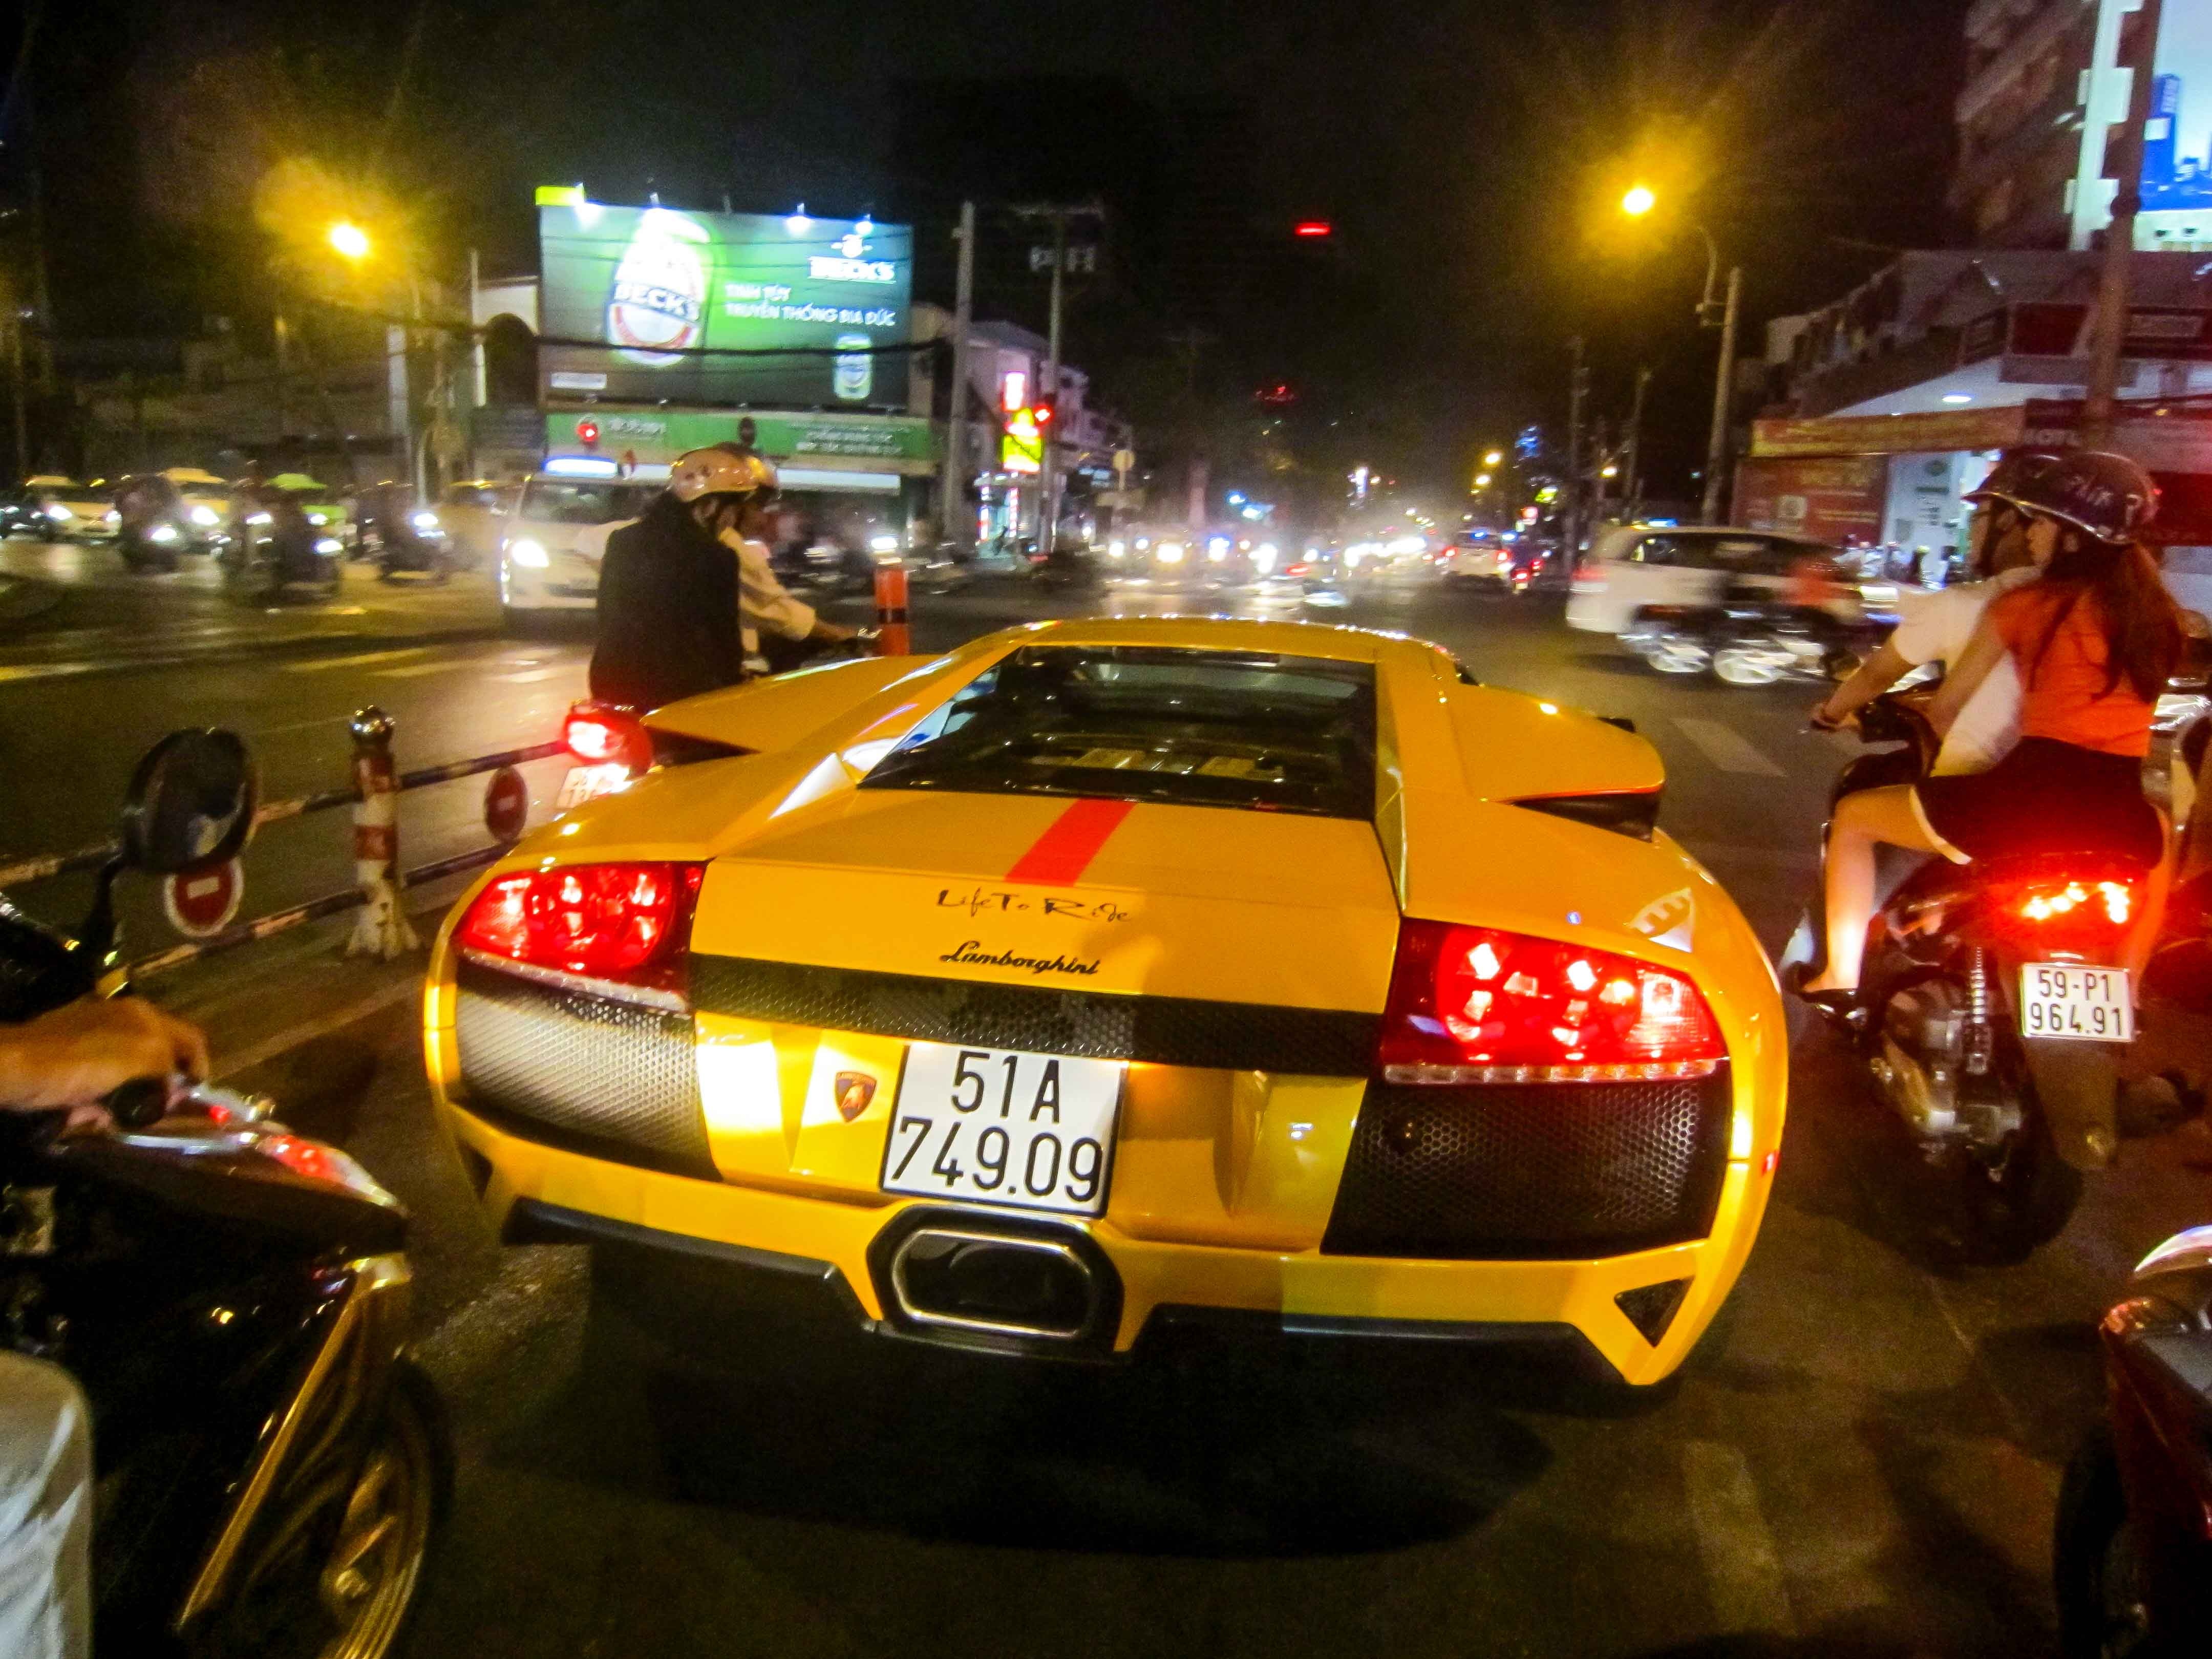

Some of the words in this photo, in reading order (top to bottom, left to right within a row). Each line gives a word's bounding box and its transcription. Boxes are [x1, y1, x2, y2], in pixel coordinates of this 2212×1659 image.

[937, 887, 992, 918] Life
[991, 893, 1029, 911] To
[1043, 898, 1129, 922] Ride
[940, 940, 1100, 975] Lamborghini
[2038, 969, 2110, 1002] 59-P1
[2030, 1002, 2122, 1036] 964.91
[951, 1051, 1060, 1123] 51A
[891, 1116, 1103, 1202] 749.09
